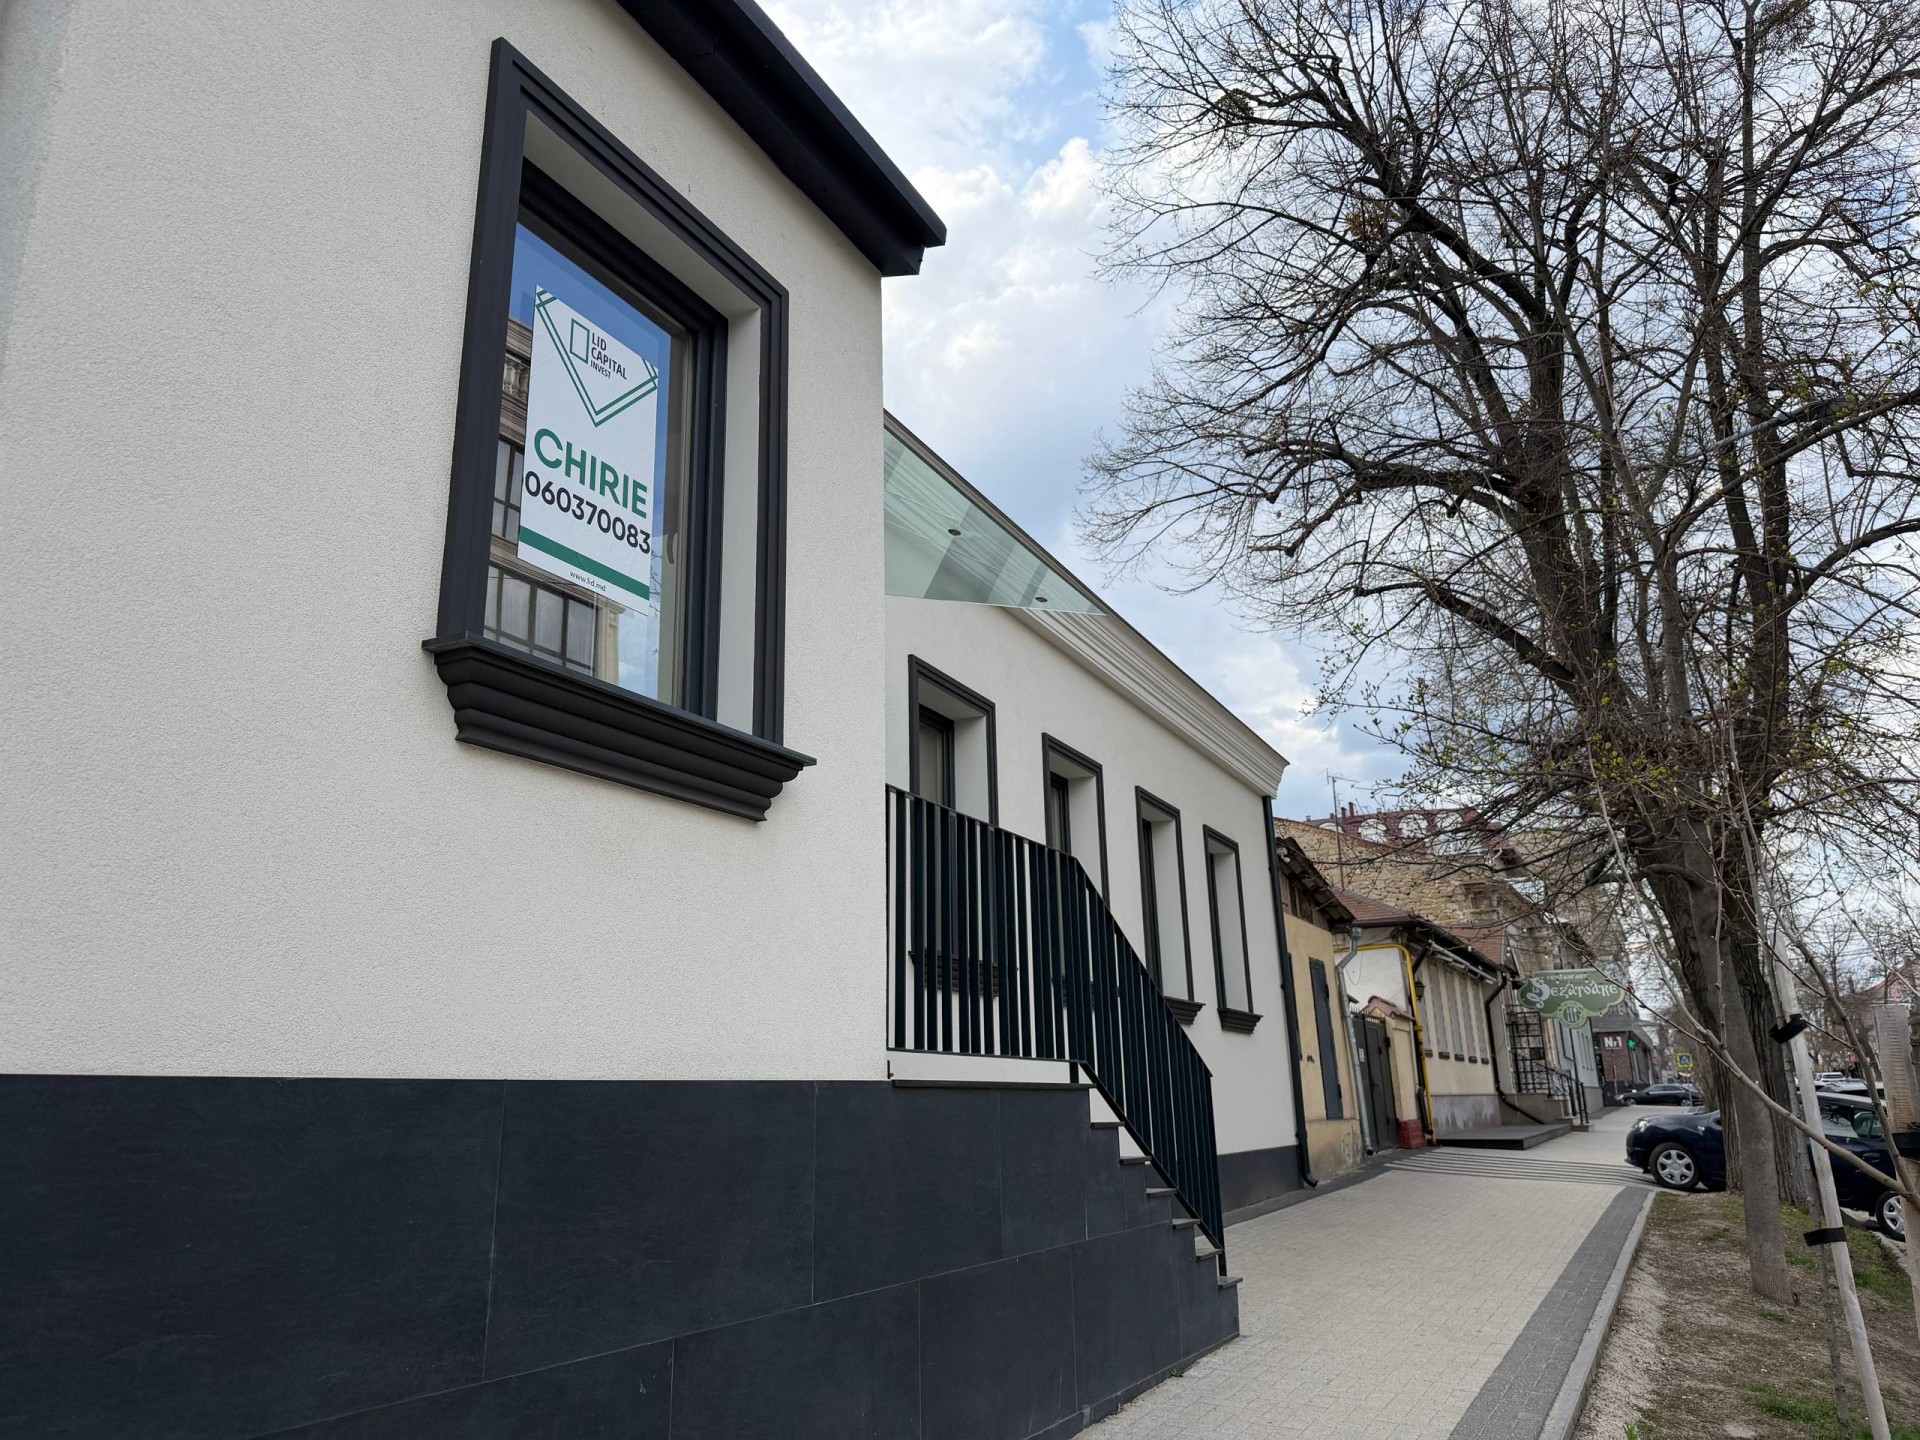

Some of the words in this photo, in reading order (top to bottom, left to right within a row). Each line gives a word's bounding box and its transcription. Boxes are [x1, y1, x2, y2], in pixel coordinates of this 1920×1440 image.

[592, 333, 607, 351] LID
[590, 360, 611, 379] INVEST
[591, 347, 627, 380] CAPITAL
[533, 428, 648, 519] CHIRIE
[524, 471, 651, 555] 060370083
[569, 571, 606, 592] www.lid.md
